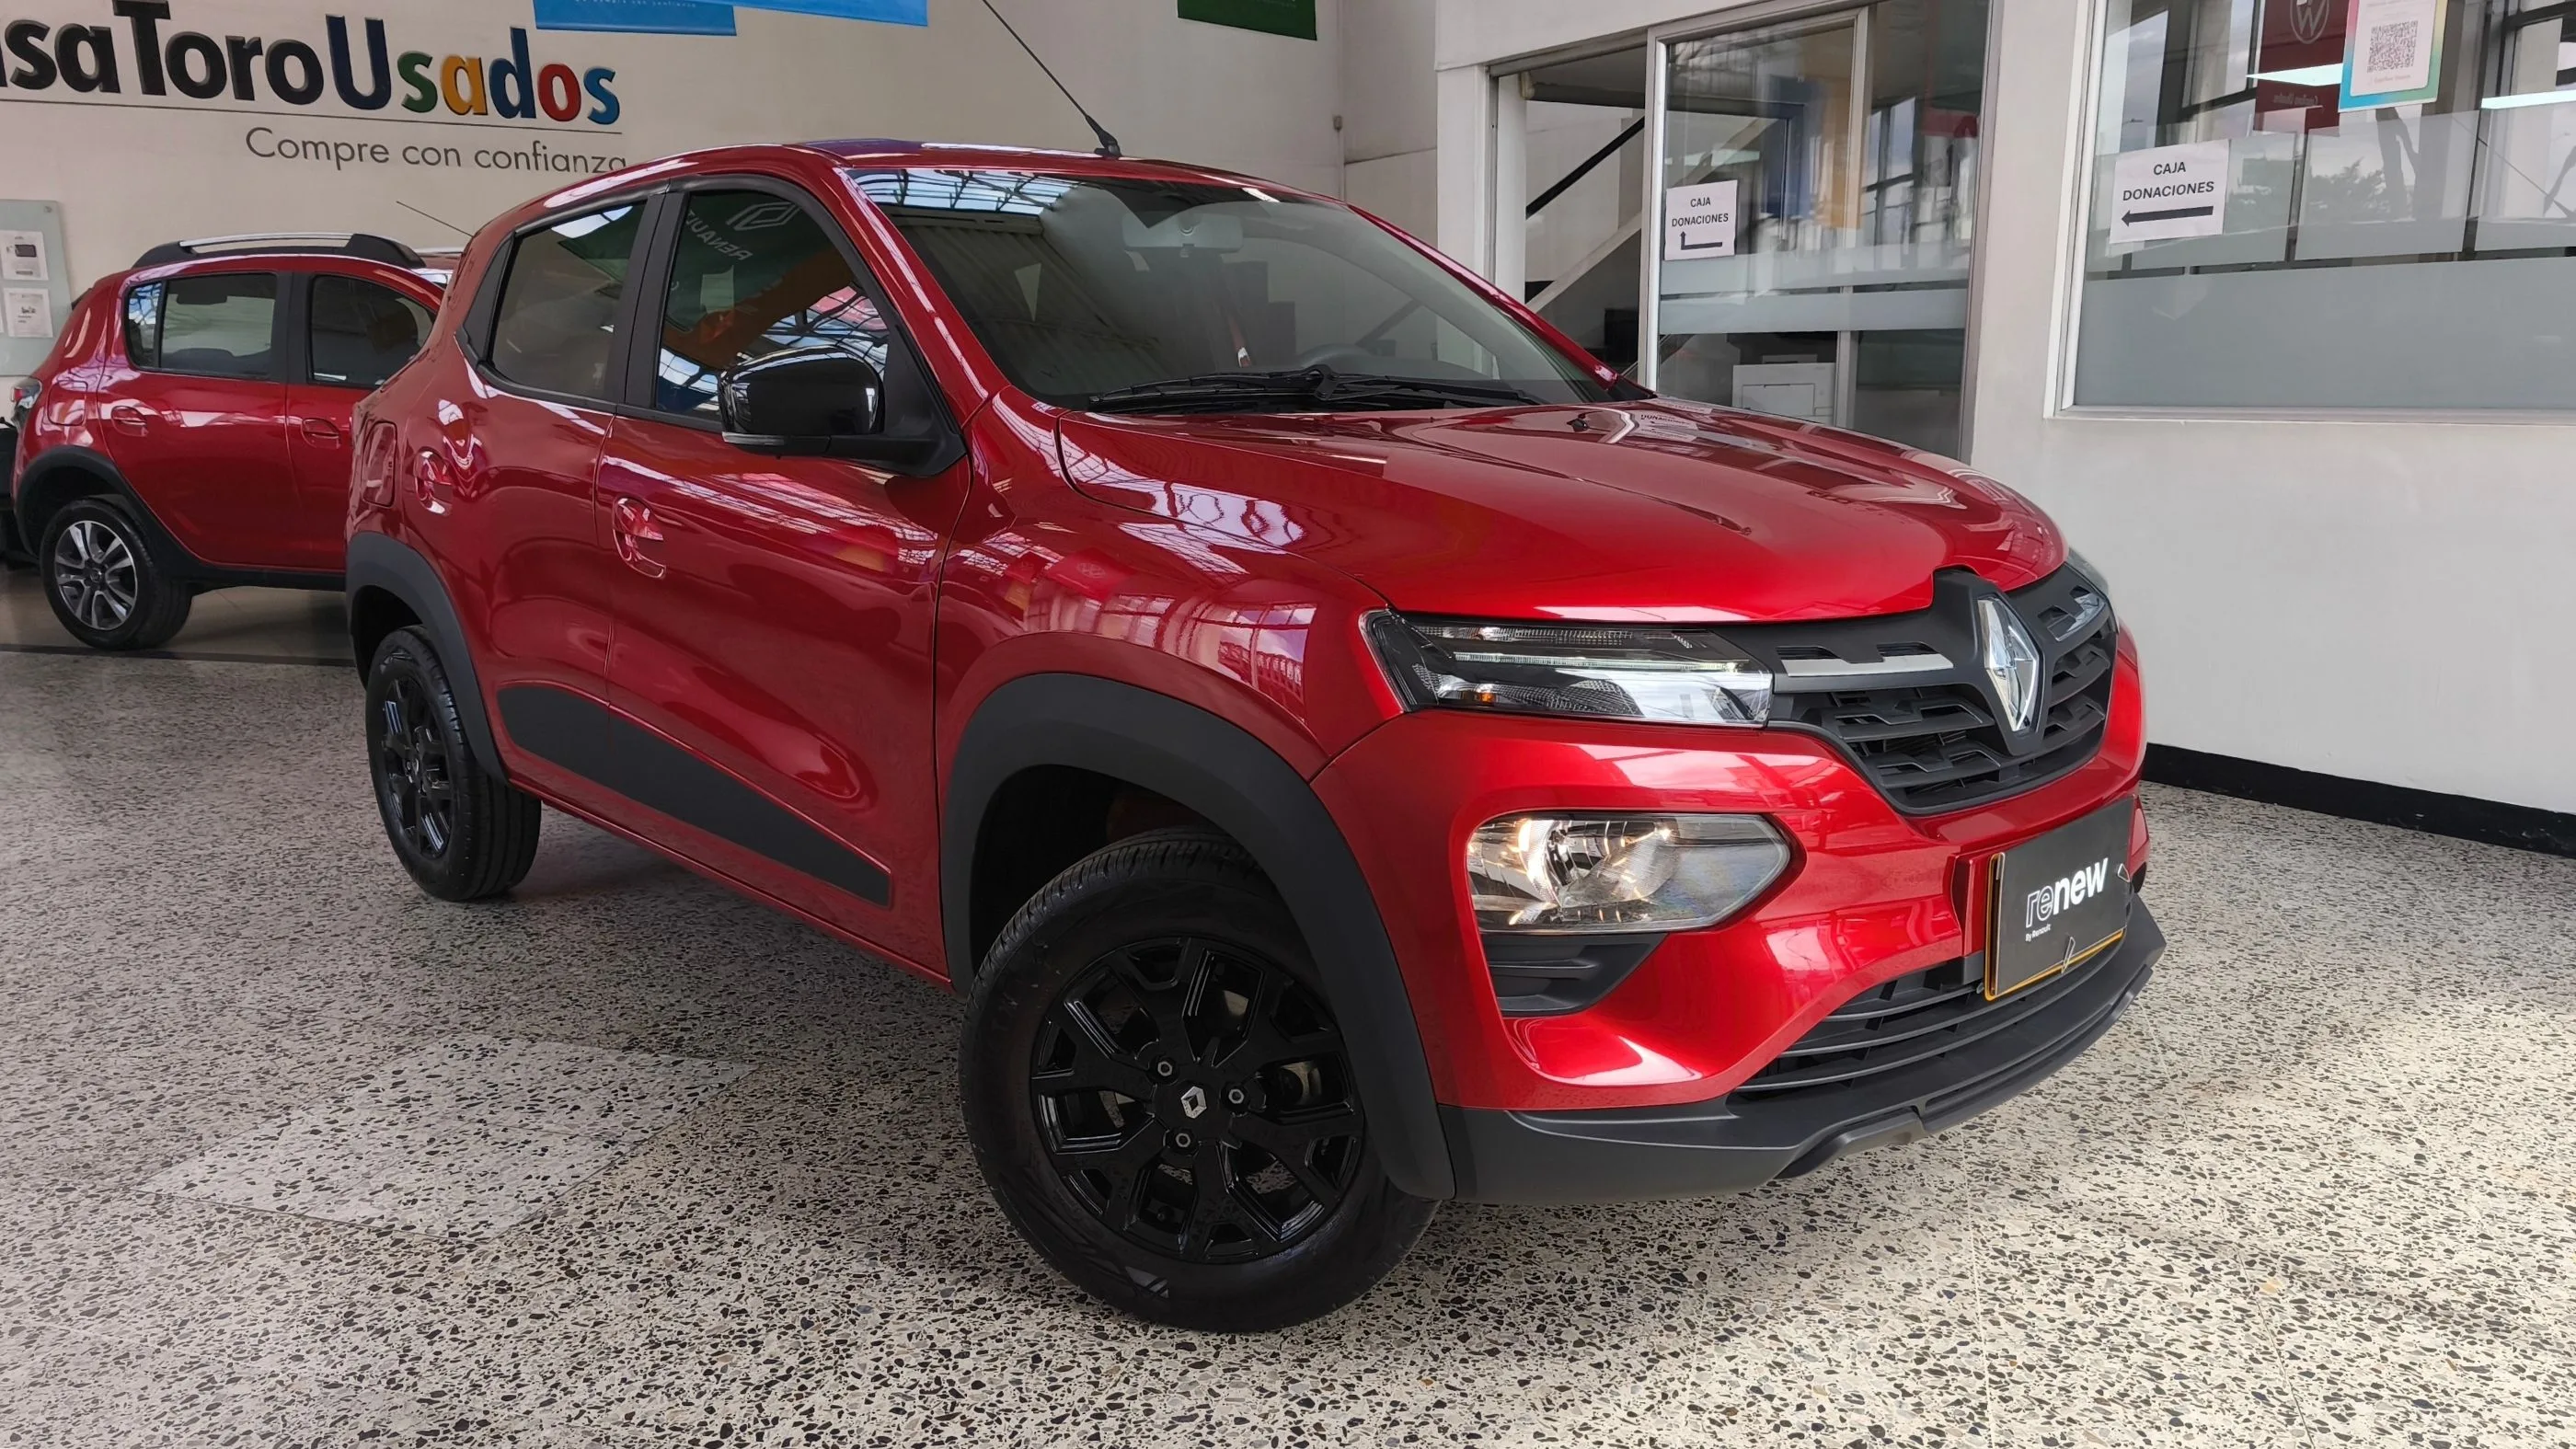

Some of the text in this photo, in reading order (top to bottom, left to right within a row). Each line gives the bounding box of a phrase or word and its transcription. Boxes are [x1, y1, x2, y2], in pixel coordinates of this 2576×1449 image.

[0, 0, 620, 125] saToroUsados
[246, 127, 627, 174] Compre con confianza
[2153, 161, 2187, 176] CAJA
[2122, 180, 2214, 201] DONACIONES
[1690, 196, 1711, 208] CAJA
[1671, 213, 1729, 227] DONACIONES
[2025, 857, 2109, 928] renew
